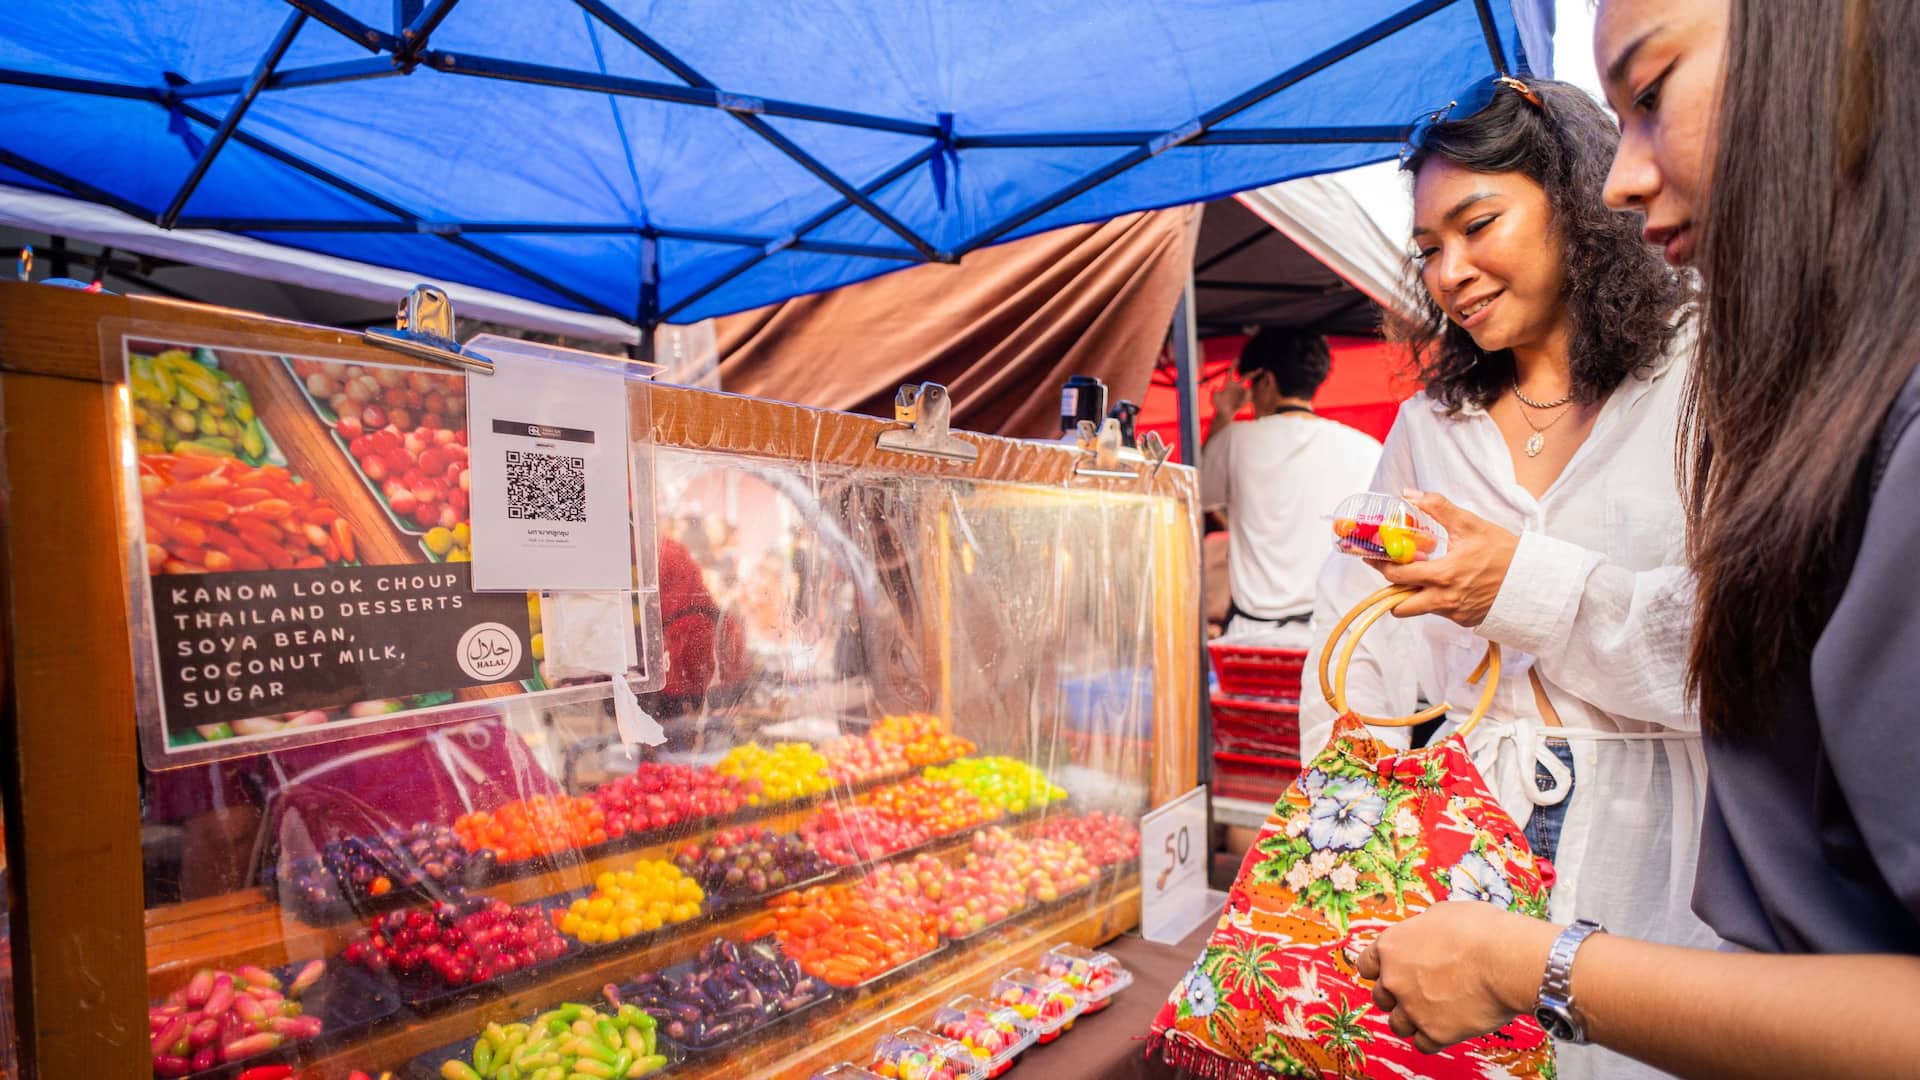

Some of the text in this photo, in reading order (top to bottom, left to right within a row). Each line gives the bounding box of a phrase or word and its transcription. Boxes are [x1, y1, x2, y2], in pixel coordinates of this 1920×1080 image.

[172, 574, 458, 604] KANOM LOOK CHOUP
[174, 595, 463, 629] THAILAND DESSERTS
[178, 627, 355, 656] SOYA BEAN,
[470, 638, 509, 660] حلال
[181, 645, 406, 681] COCONUT MILK,
[477, 659, 505, 669] HALAL
[184, 682, 283, 707] SUGAR
